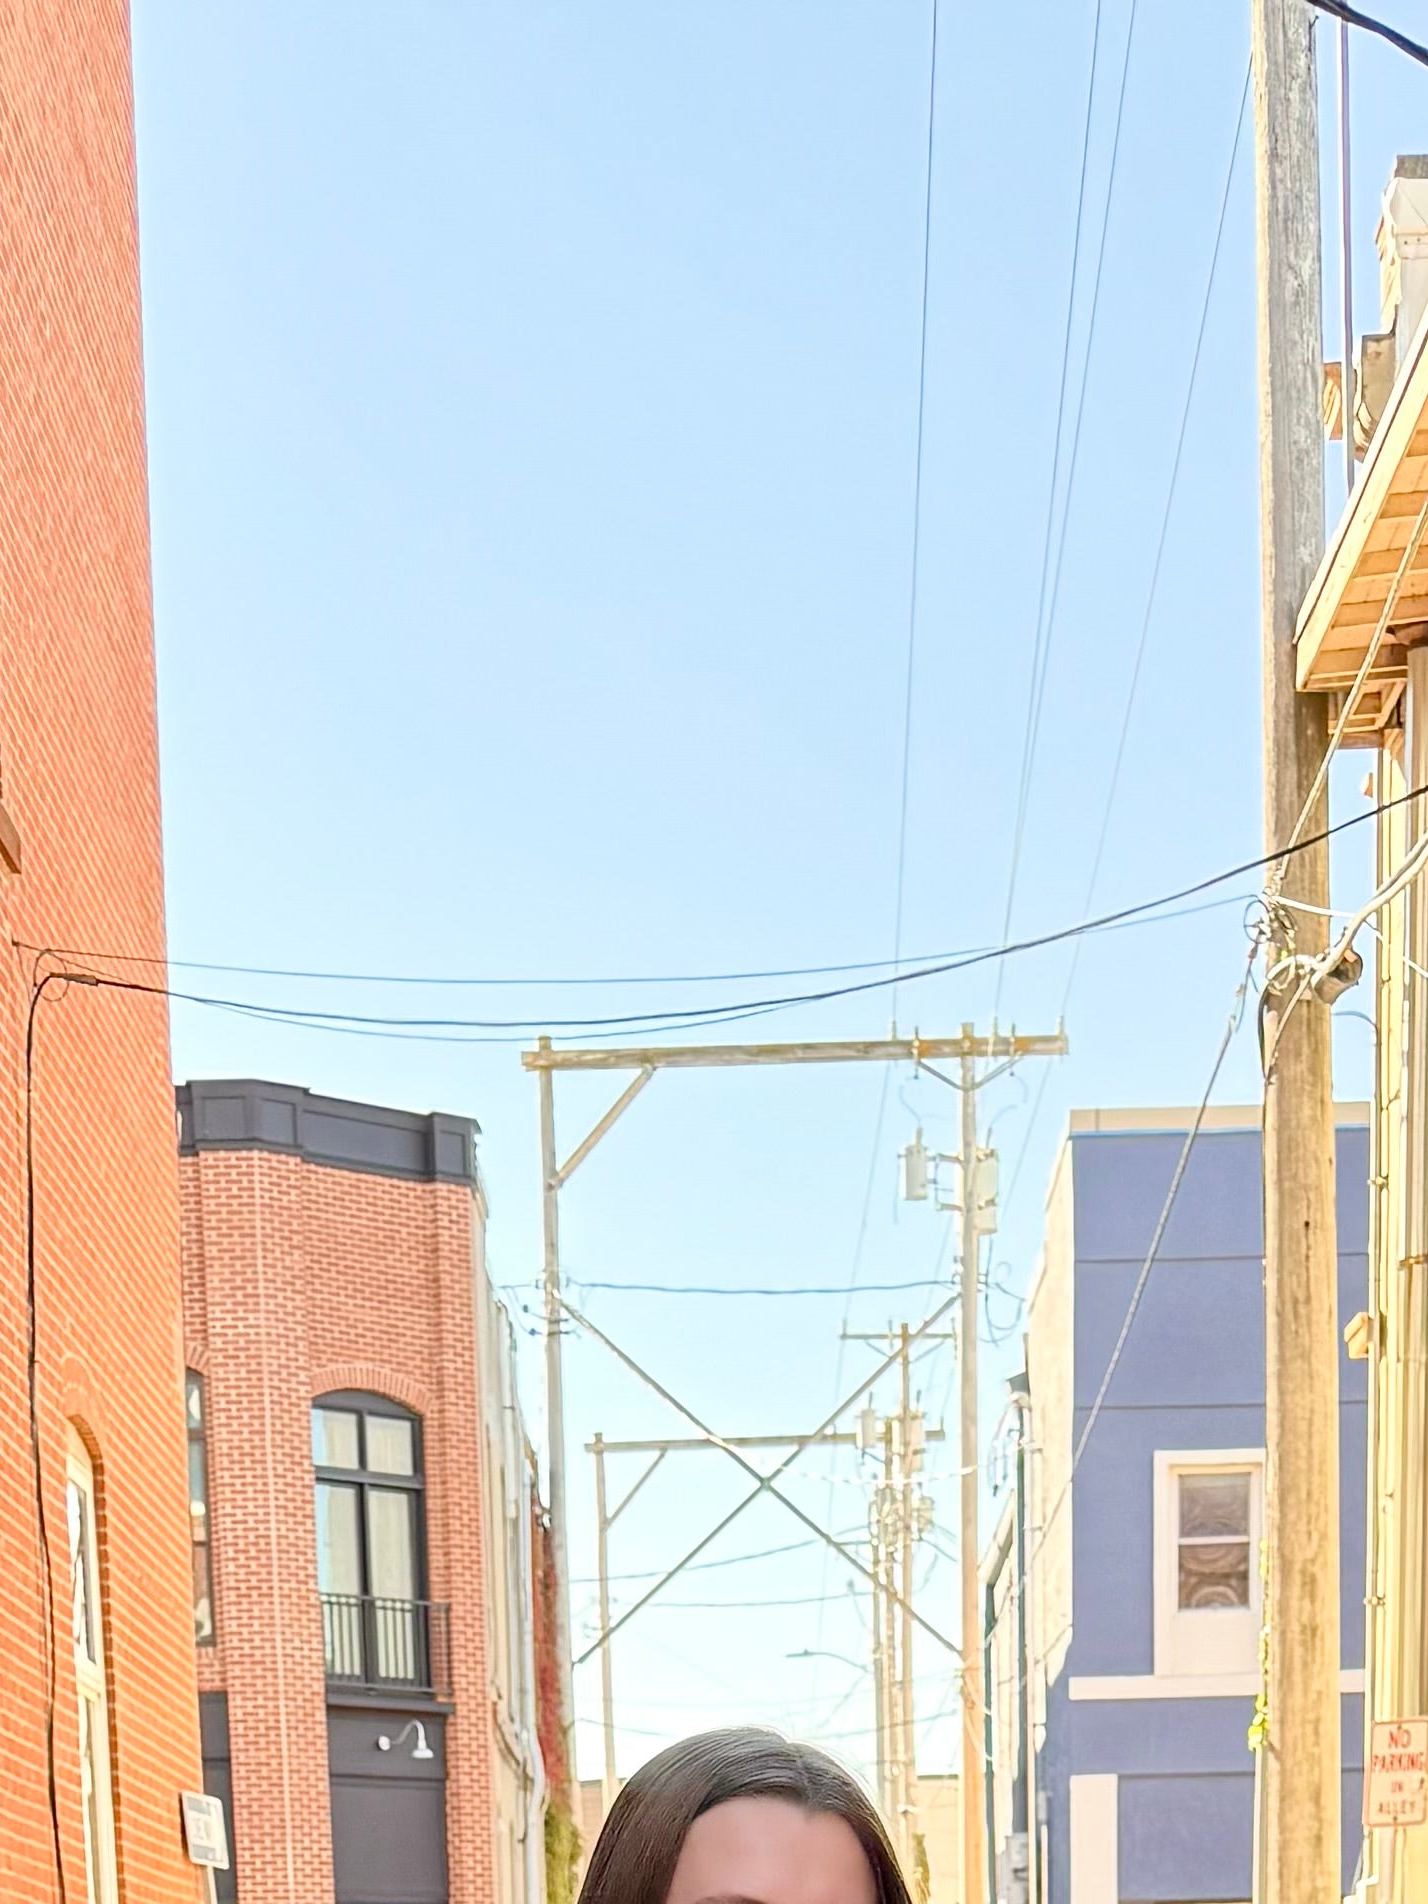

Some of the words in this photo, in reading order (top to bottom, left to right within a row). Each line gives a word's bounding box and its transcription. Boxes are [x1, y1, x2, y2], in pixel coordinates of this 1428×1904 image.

[1388, 1728, 1412, 1749] NO
[1373, 1751, 1424, 1772] PARKING
[1378, 1800, 1416, 1815] ALLEY
